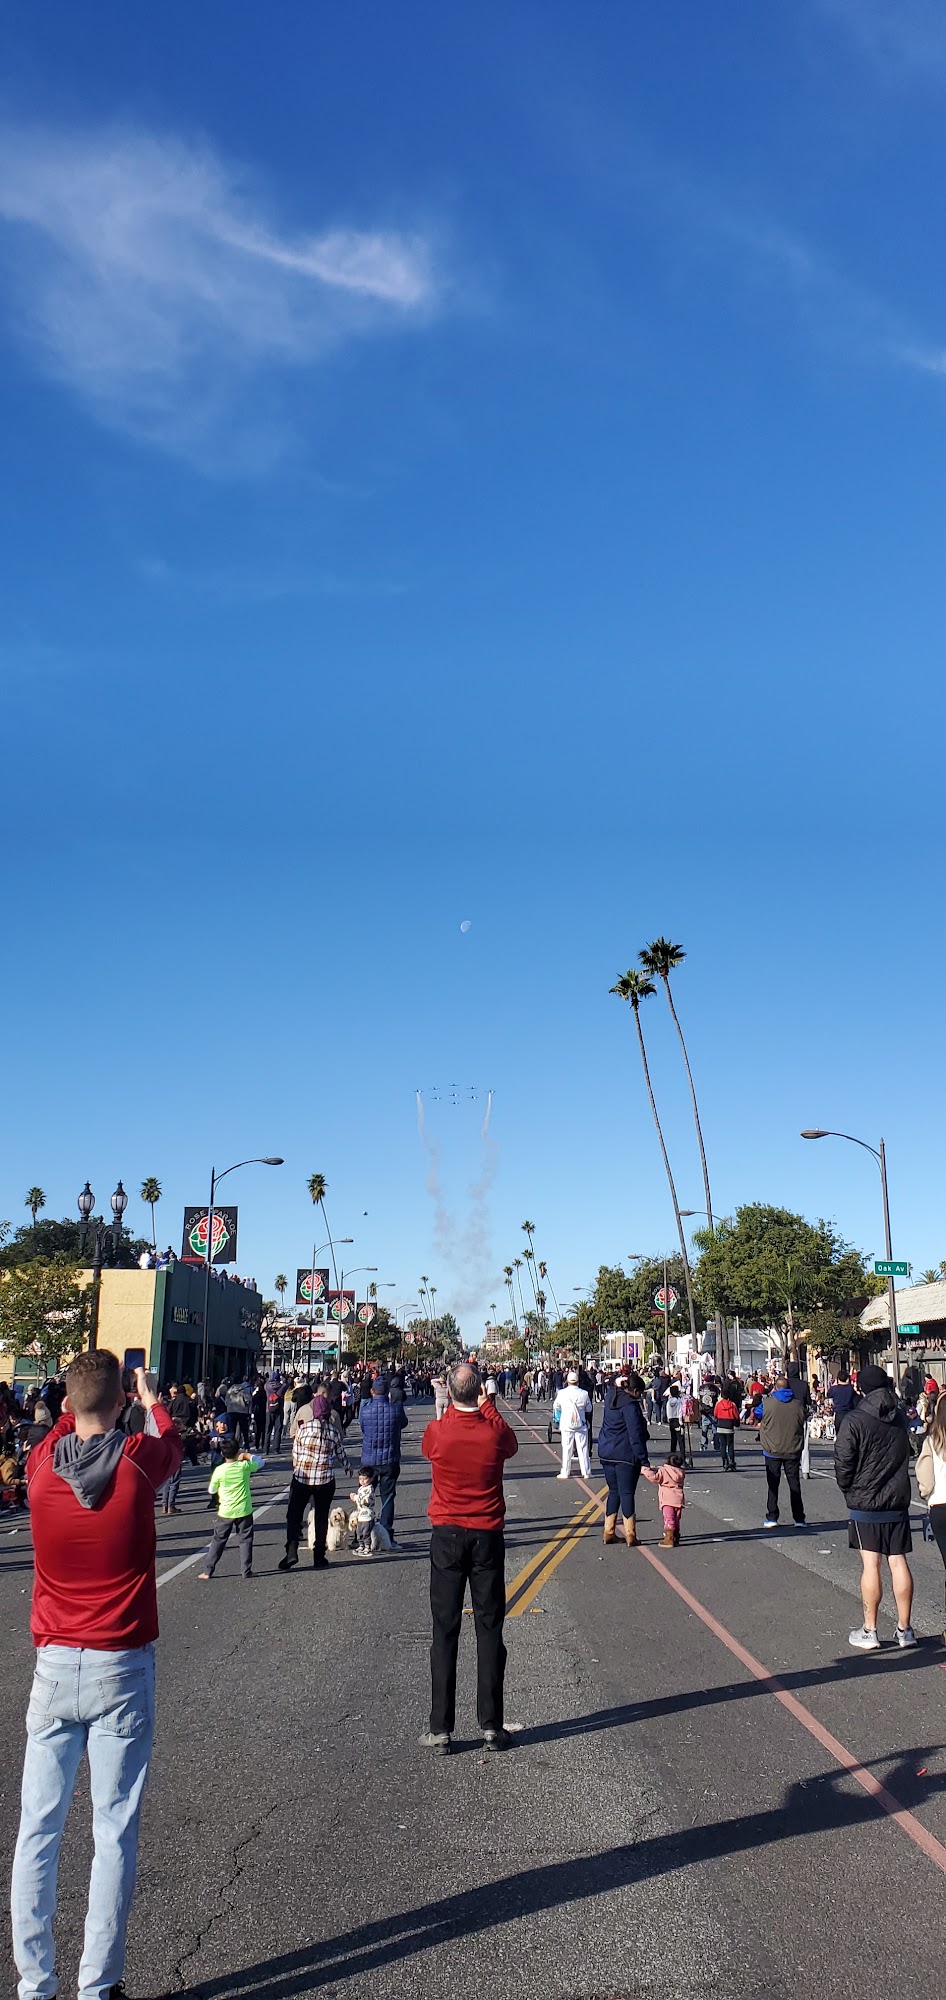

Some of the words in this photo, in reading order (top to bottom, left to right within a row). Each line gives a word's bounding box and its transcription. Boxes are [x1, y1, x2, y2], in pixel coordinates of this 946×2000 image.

[185, 1210, 206, 1230] ROSE
[213, 1209, 236, 1235] PARADE
[877, 1264, 892, 1272] Oak
